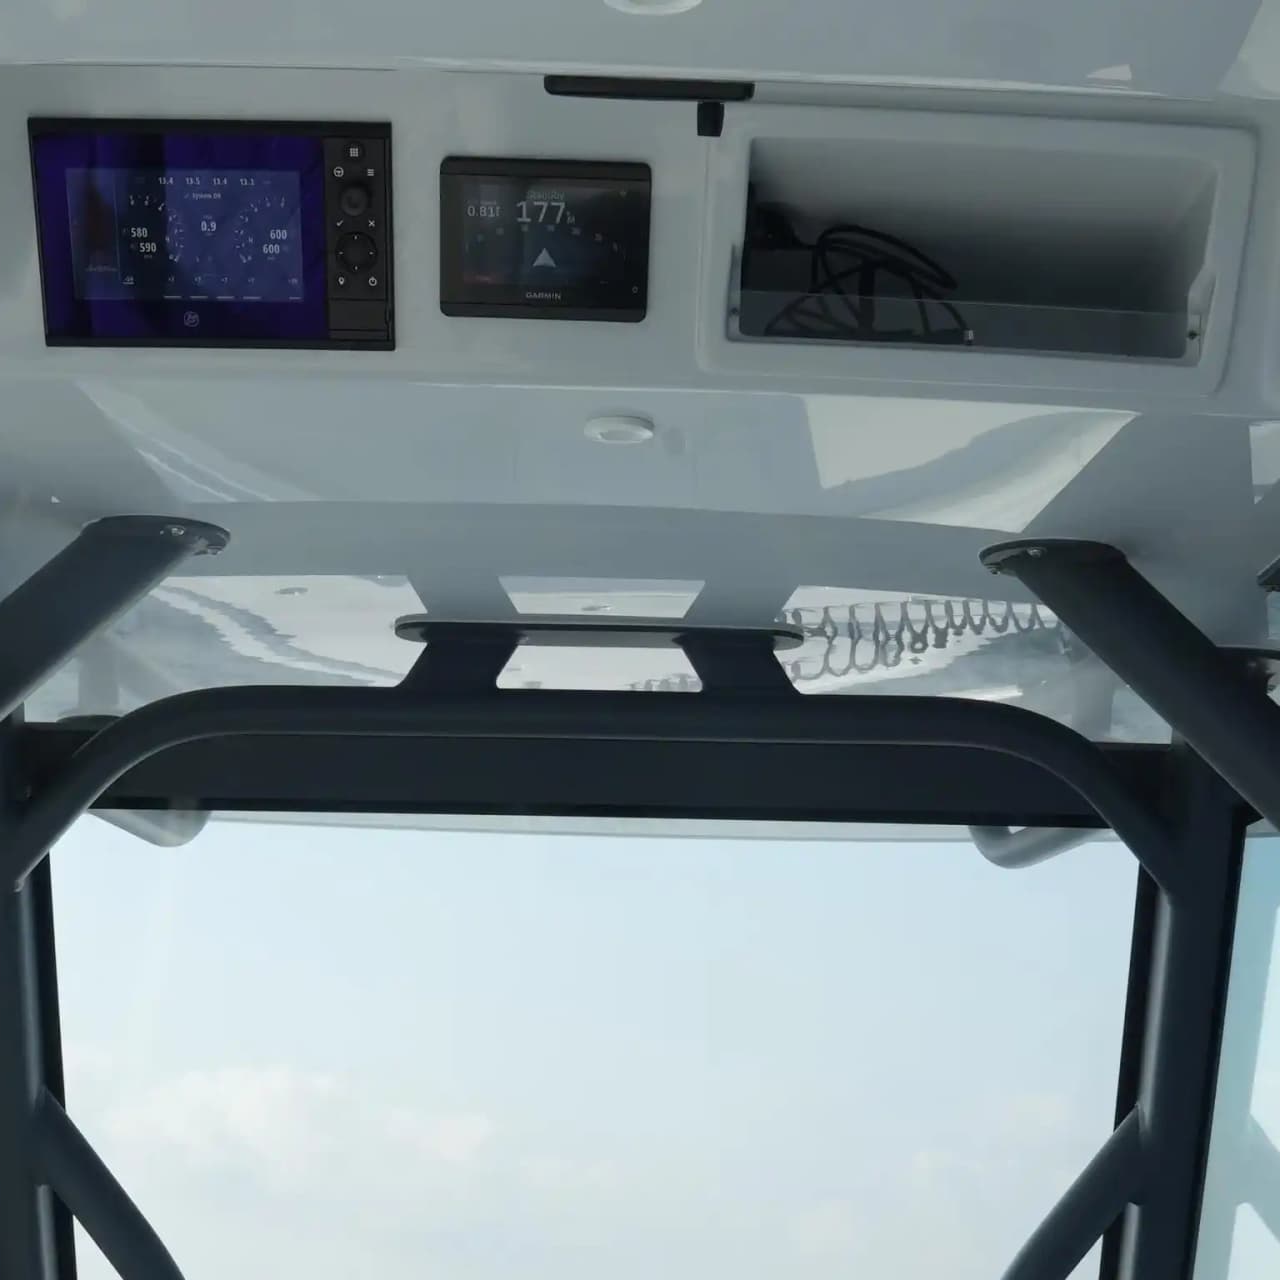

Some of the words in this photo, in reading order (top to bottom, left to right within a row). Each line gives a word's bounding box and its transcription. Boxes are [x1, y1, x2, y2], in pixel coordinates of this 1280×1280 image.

[131, 227, 148, 238] 580
[270, 229, 288, 240] 600
[139, 242, 157, 253] 590
[263, 244, 280, 255] 600
[525, 291, 561, 301] GARMIN
